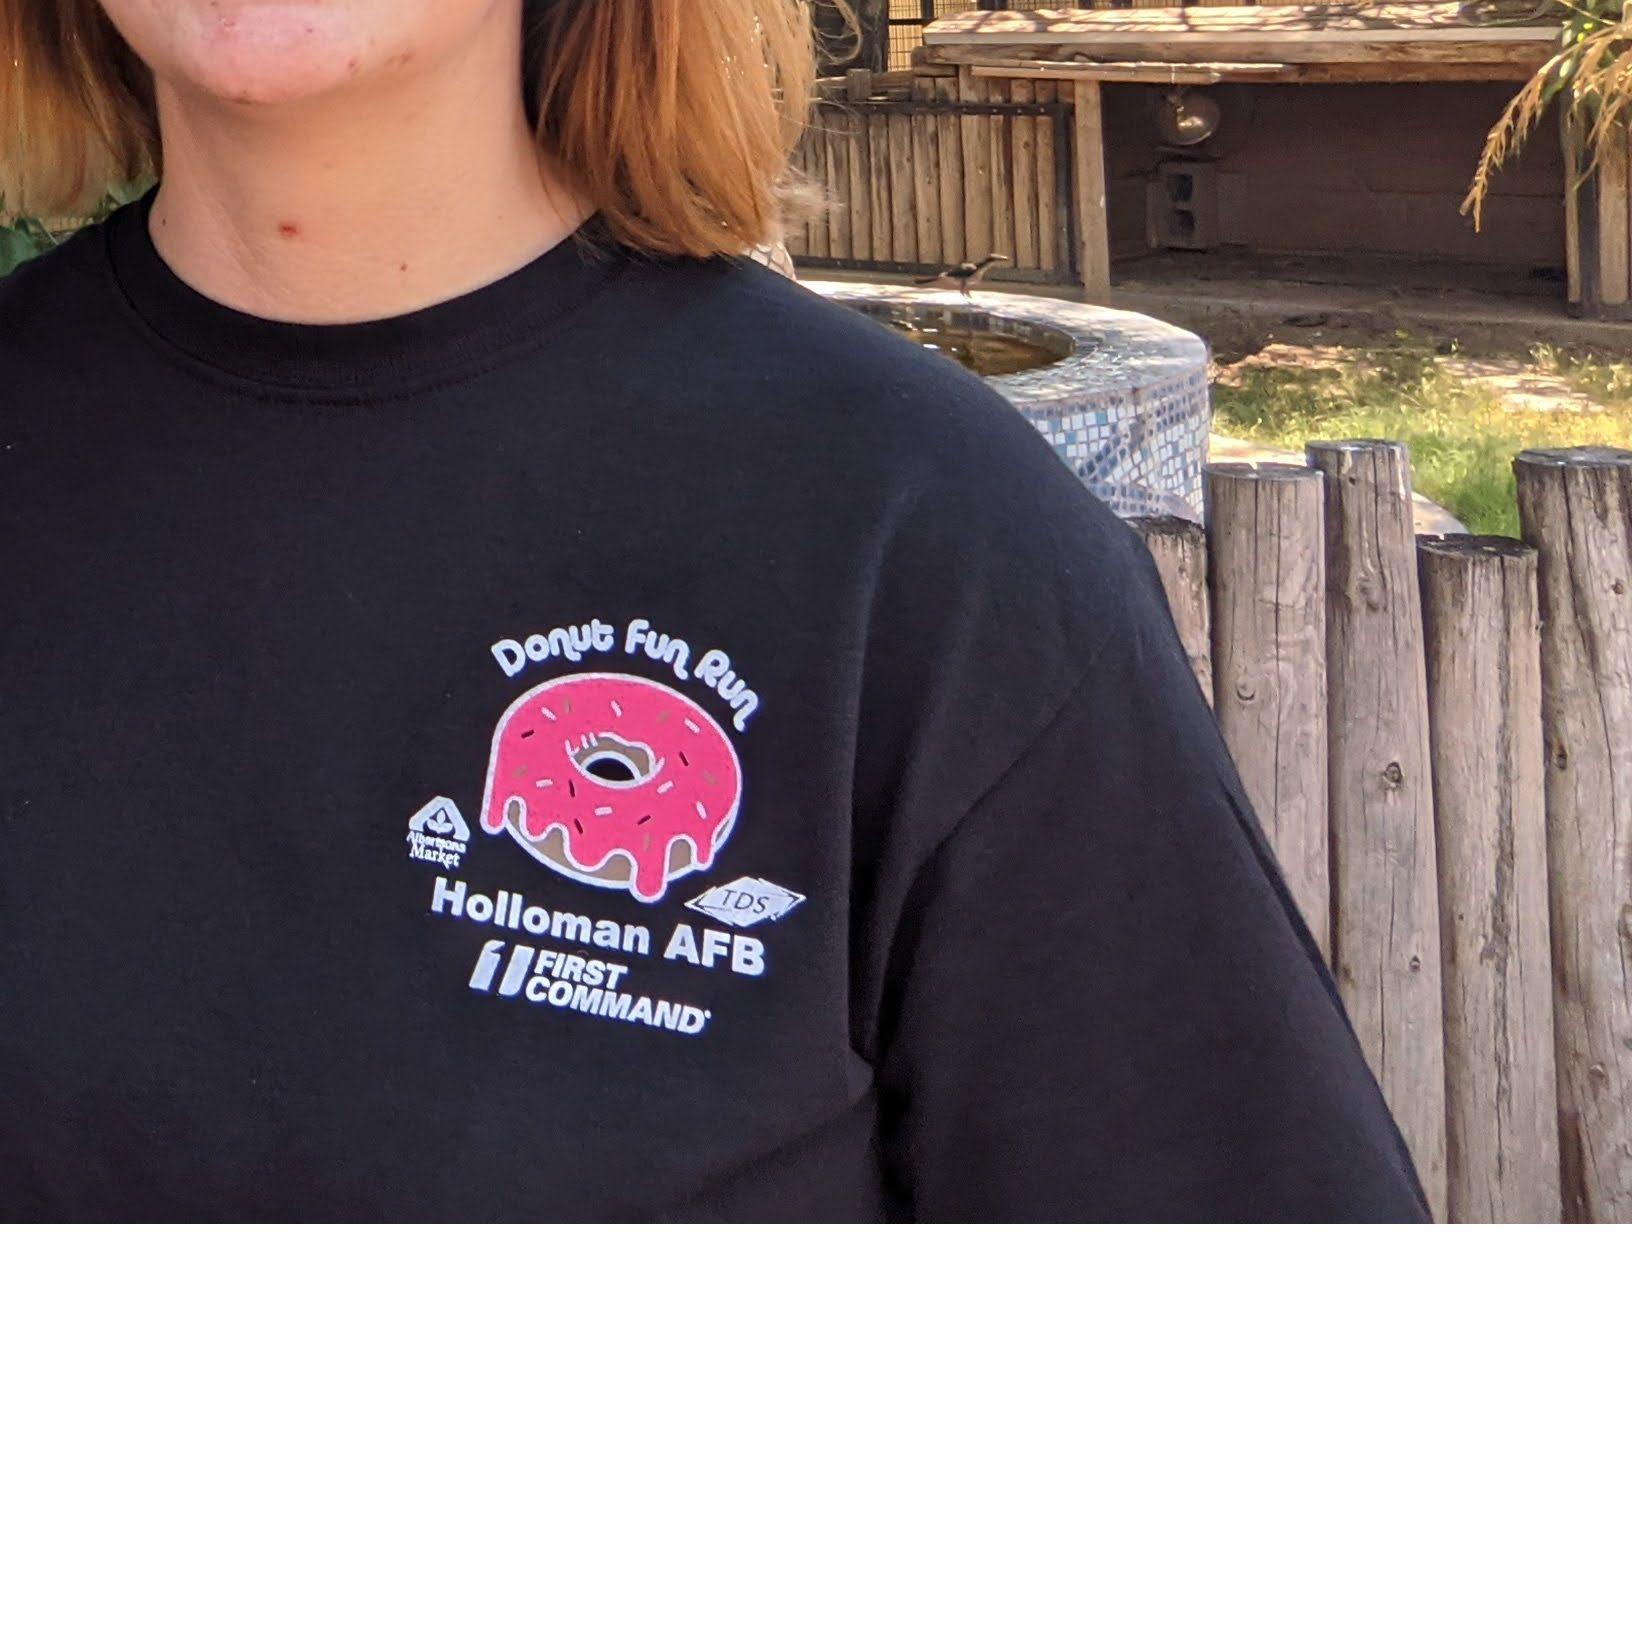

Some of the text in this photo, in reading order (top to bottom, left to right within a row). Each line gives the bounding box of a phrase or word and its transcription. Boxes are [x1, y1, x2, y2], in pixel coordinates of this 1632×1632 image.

[491, 618, 760, 732] Donut Fun Run
[408, 842, 461, 870] Market
[431, 876, 766, 977] Holloman AFB
[722, 889, 770, 915] TDS
[534, 949, 629, 990] FIRST
[525, 975, 712, 1034] COMMAND
